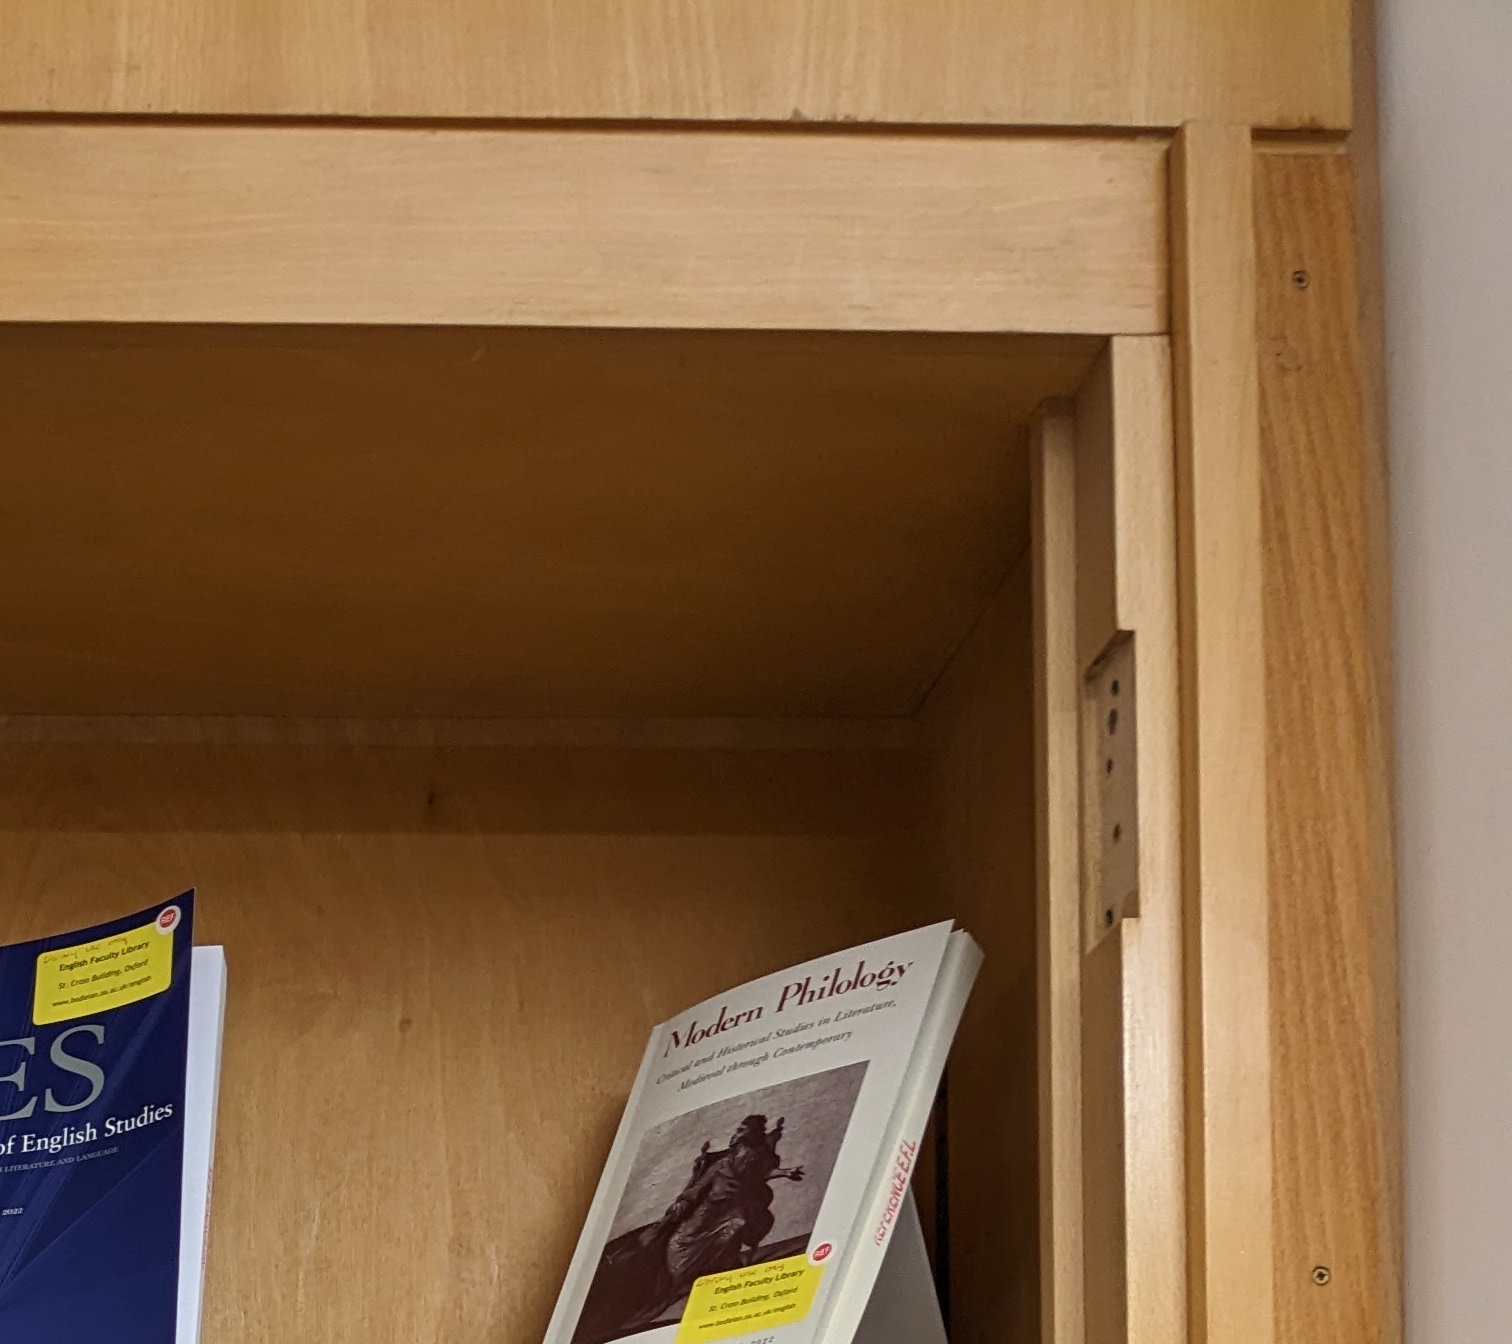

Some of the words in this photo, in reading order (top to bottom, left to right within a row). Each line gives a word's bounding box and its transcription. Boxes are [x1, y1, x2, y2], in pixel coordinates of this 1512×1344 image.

[663, 1005, 763, 1058] Modern
[776, 959, 914, 1013] Philology
[22, 1125, 98, 1153] English
[105, 1104, 174, 1137] Studies
